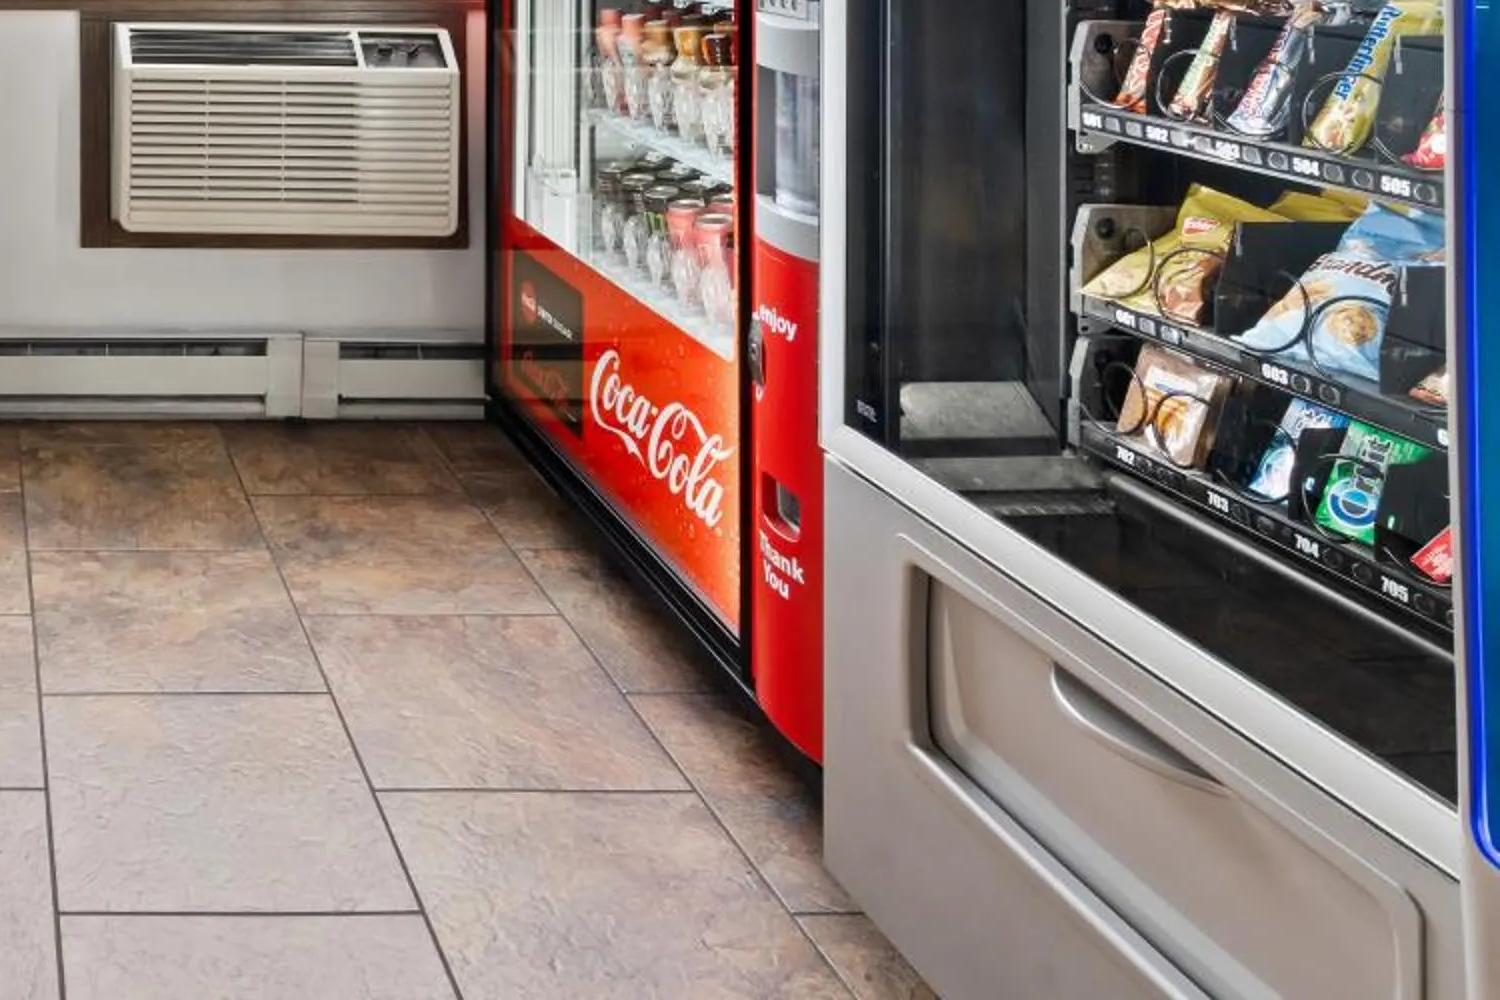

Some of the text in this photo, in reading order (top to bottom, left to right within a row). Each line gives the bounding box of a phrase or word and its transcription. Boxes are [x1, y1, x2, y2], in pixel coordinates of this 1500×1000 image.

[1291, 156, 1320, 177] 504
[1380, 175, 1411, 198] 505
[590, 350, 736, 528] Coca-Cola
[1294, 533, 1320, 558] 704
[763, 558, 789, 600] You
[1381, 575, 1409, 603] 705
